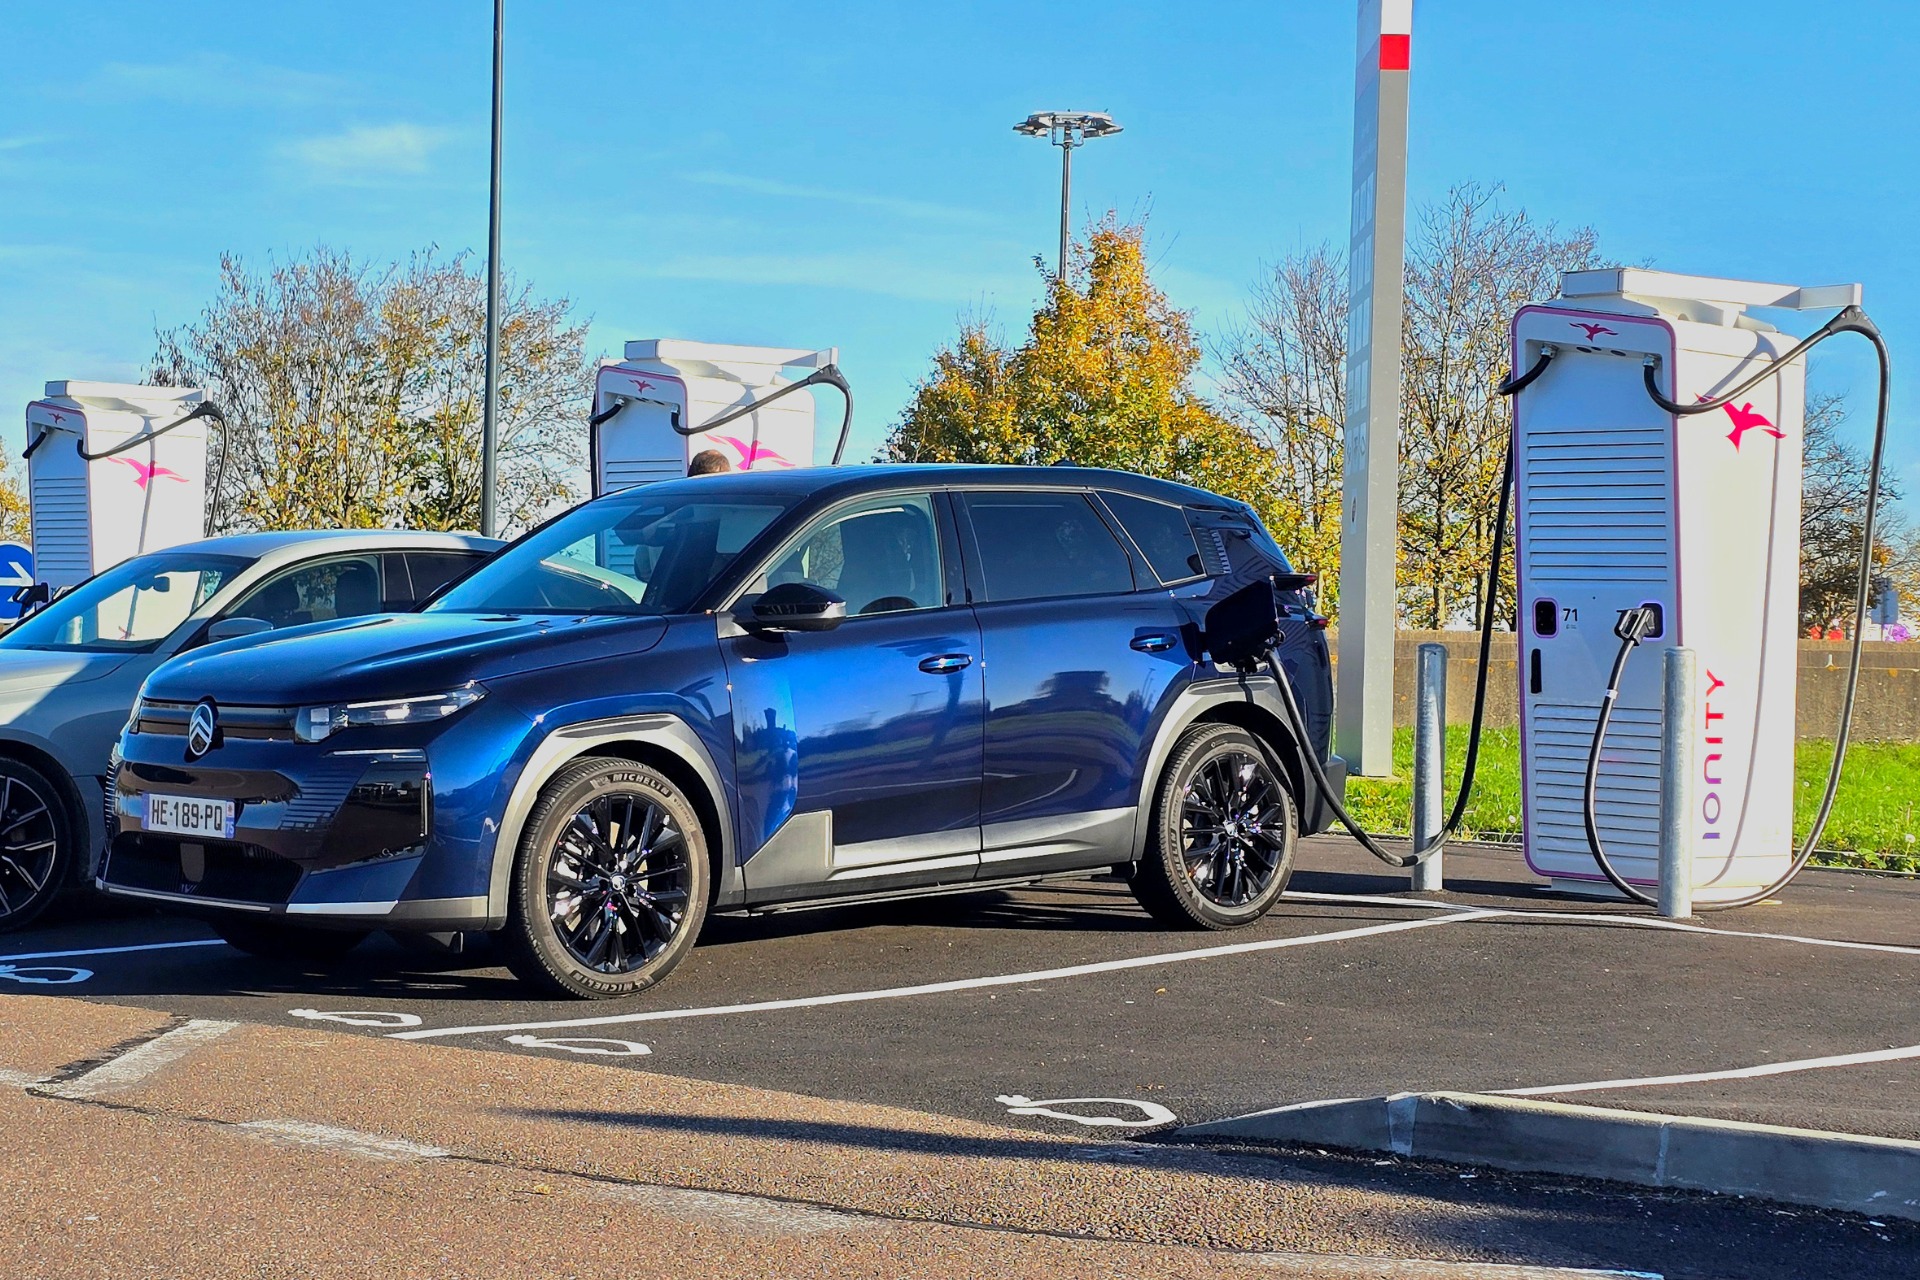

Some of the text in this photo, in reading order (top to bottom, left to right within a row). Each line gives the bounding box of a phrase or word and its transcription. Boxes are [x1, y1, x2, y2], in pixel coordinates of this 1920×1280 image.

[1563, 607, 1578, 622] 71
[1702, 668, 1725, 839] IONITY
[613, 773, 670, 796] MICHELIN
[225, 821, 235, 834] 75
[1170, 830, 1192, 893] MICHELIN
[572, 972, 633, 993] MICHELIN
